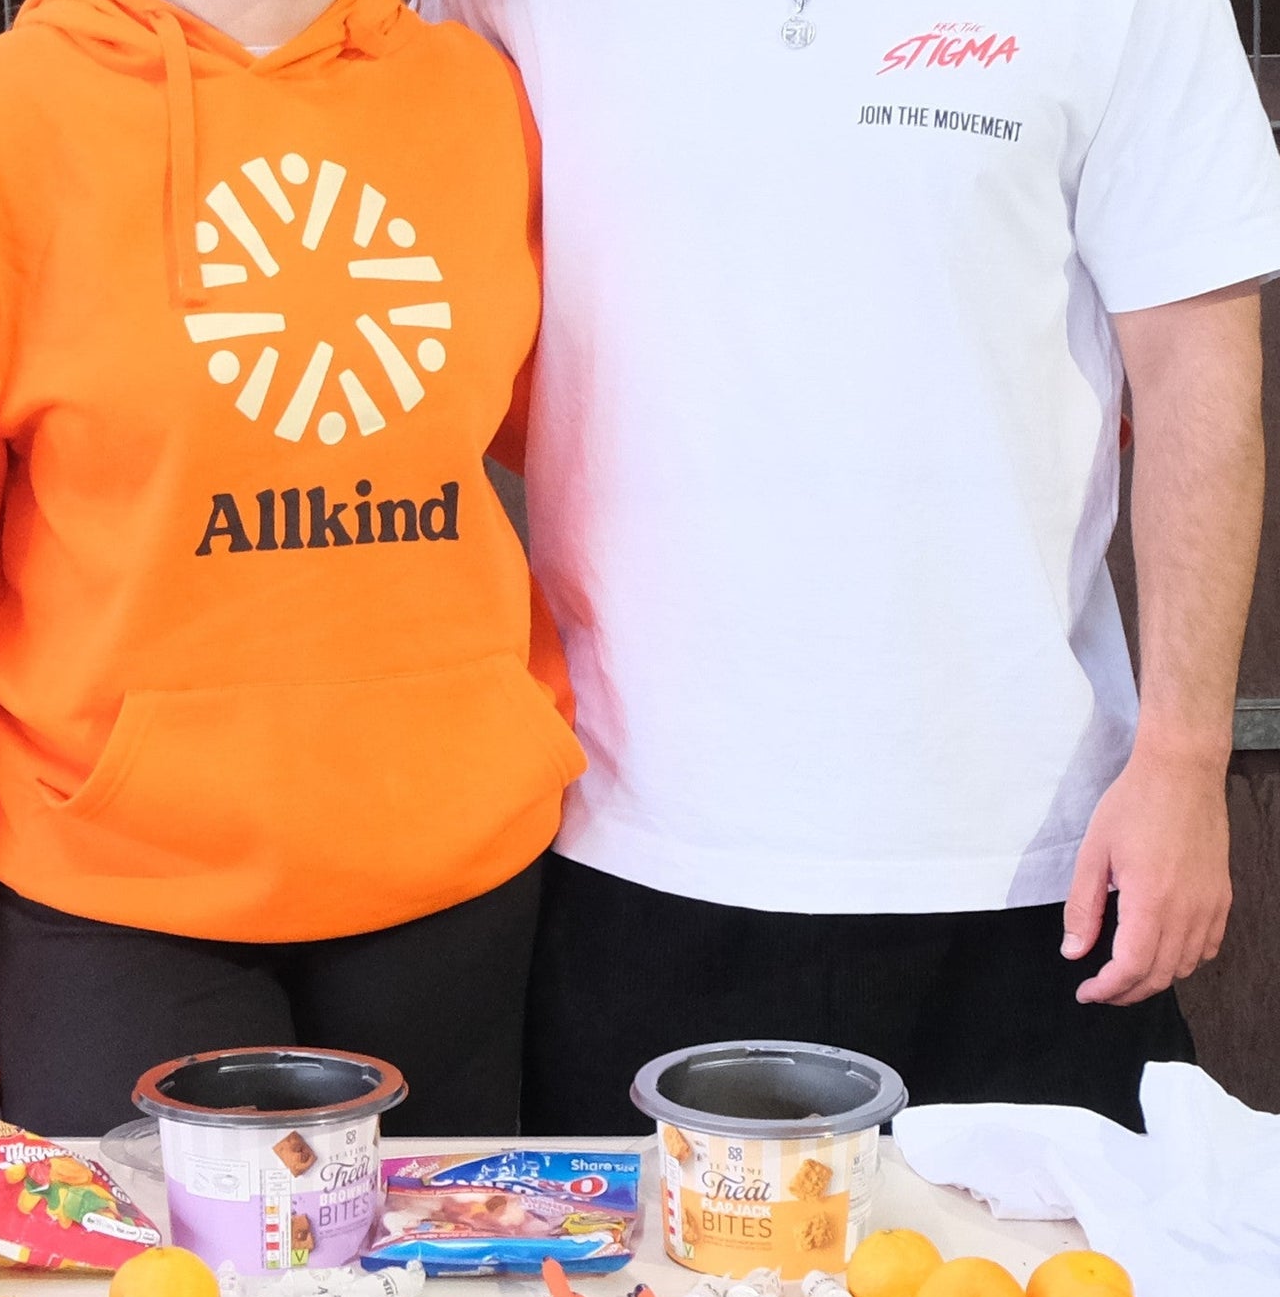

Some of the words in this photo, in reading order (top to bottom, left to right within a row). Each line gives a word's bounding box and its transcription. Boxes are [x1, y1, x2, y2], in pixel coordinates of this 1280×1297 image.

[876, 33, 1020, 76] STIGMA
[857, 105, 893, 125] JOIN
[898, 105, 930, 128] THE
[933, 108, 1023, 143] MOVEMENT
[195, 479, 459, 557] Allkind
[320, 1154, 370, 1194] Treat
[570, 1158, 613, 1172] Share
[701, 1169, 772, 1202] Treat
[319, 1192, 370, 1228] BITES
[701, 1199, 772, 1219] FLAPJACK
[702, 1210, 772, 1239] BITES
